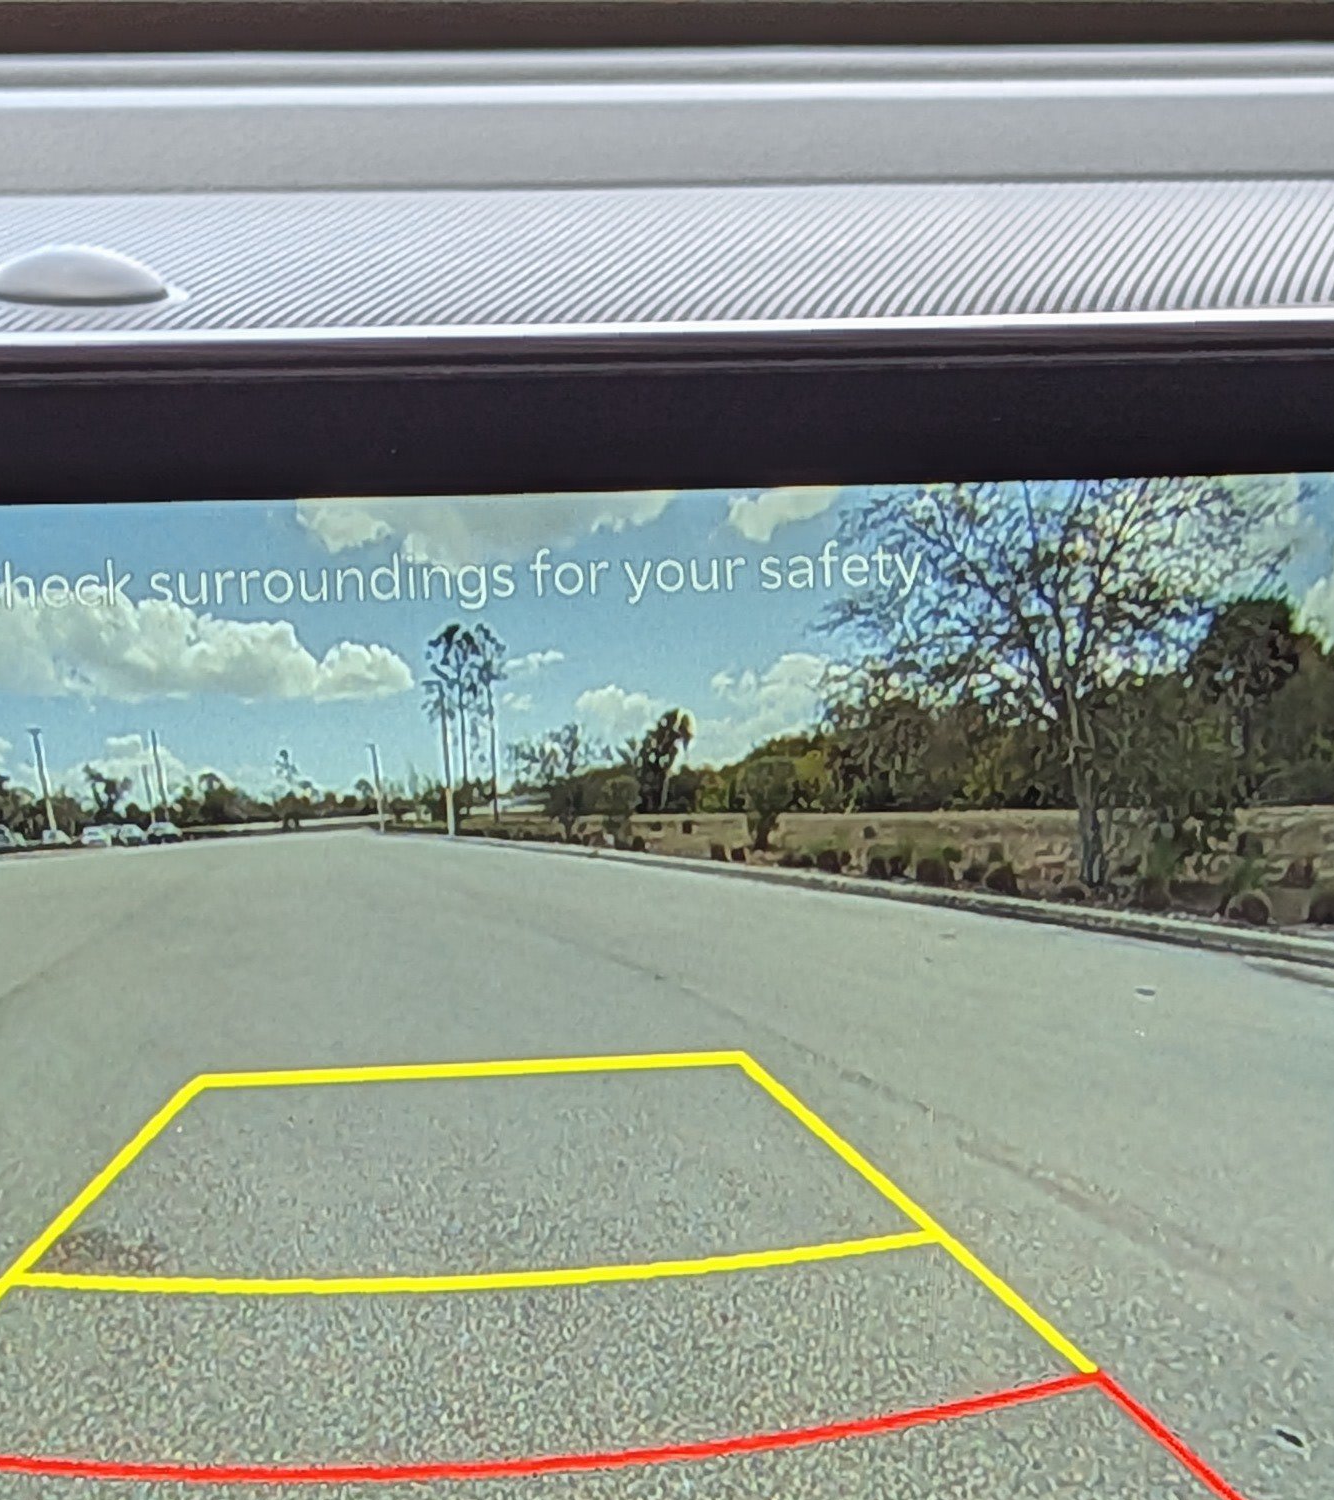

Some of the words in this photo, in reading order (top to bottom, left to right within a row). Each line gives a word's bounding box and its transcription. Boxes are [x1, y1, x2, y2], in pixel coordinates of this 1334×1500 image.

[150, 552, 515, 610] surroundings
[530, 548, 608, 597] for
[624, 557, 745, 604] your
